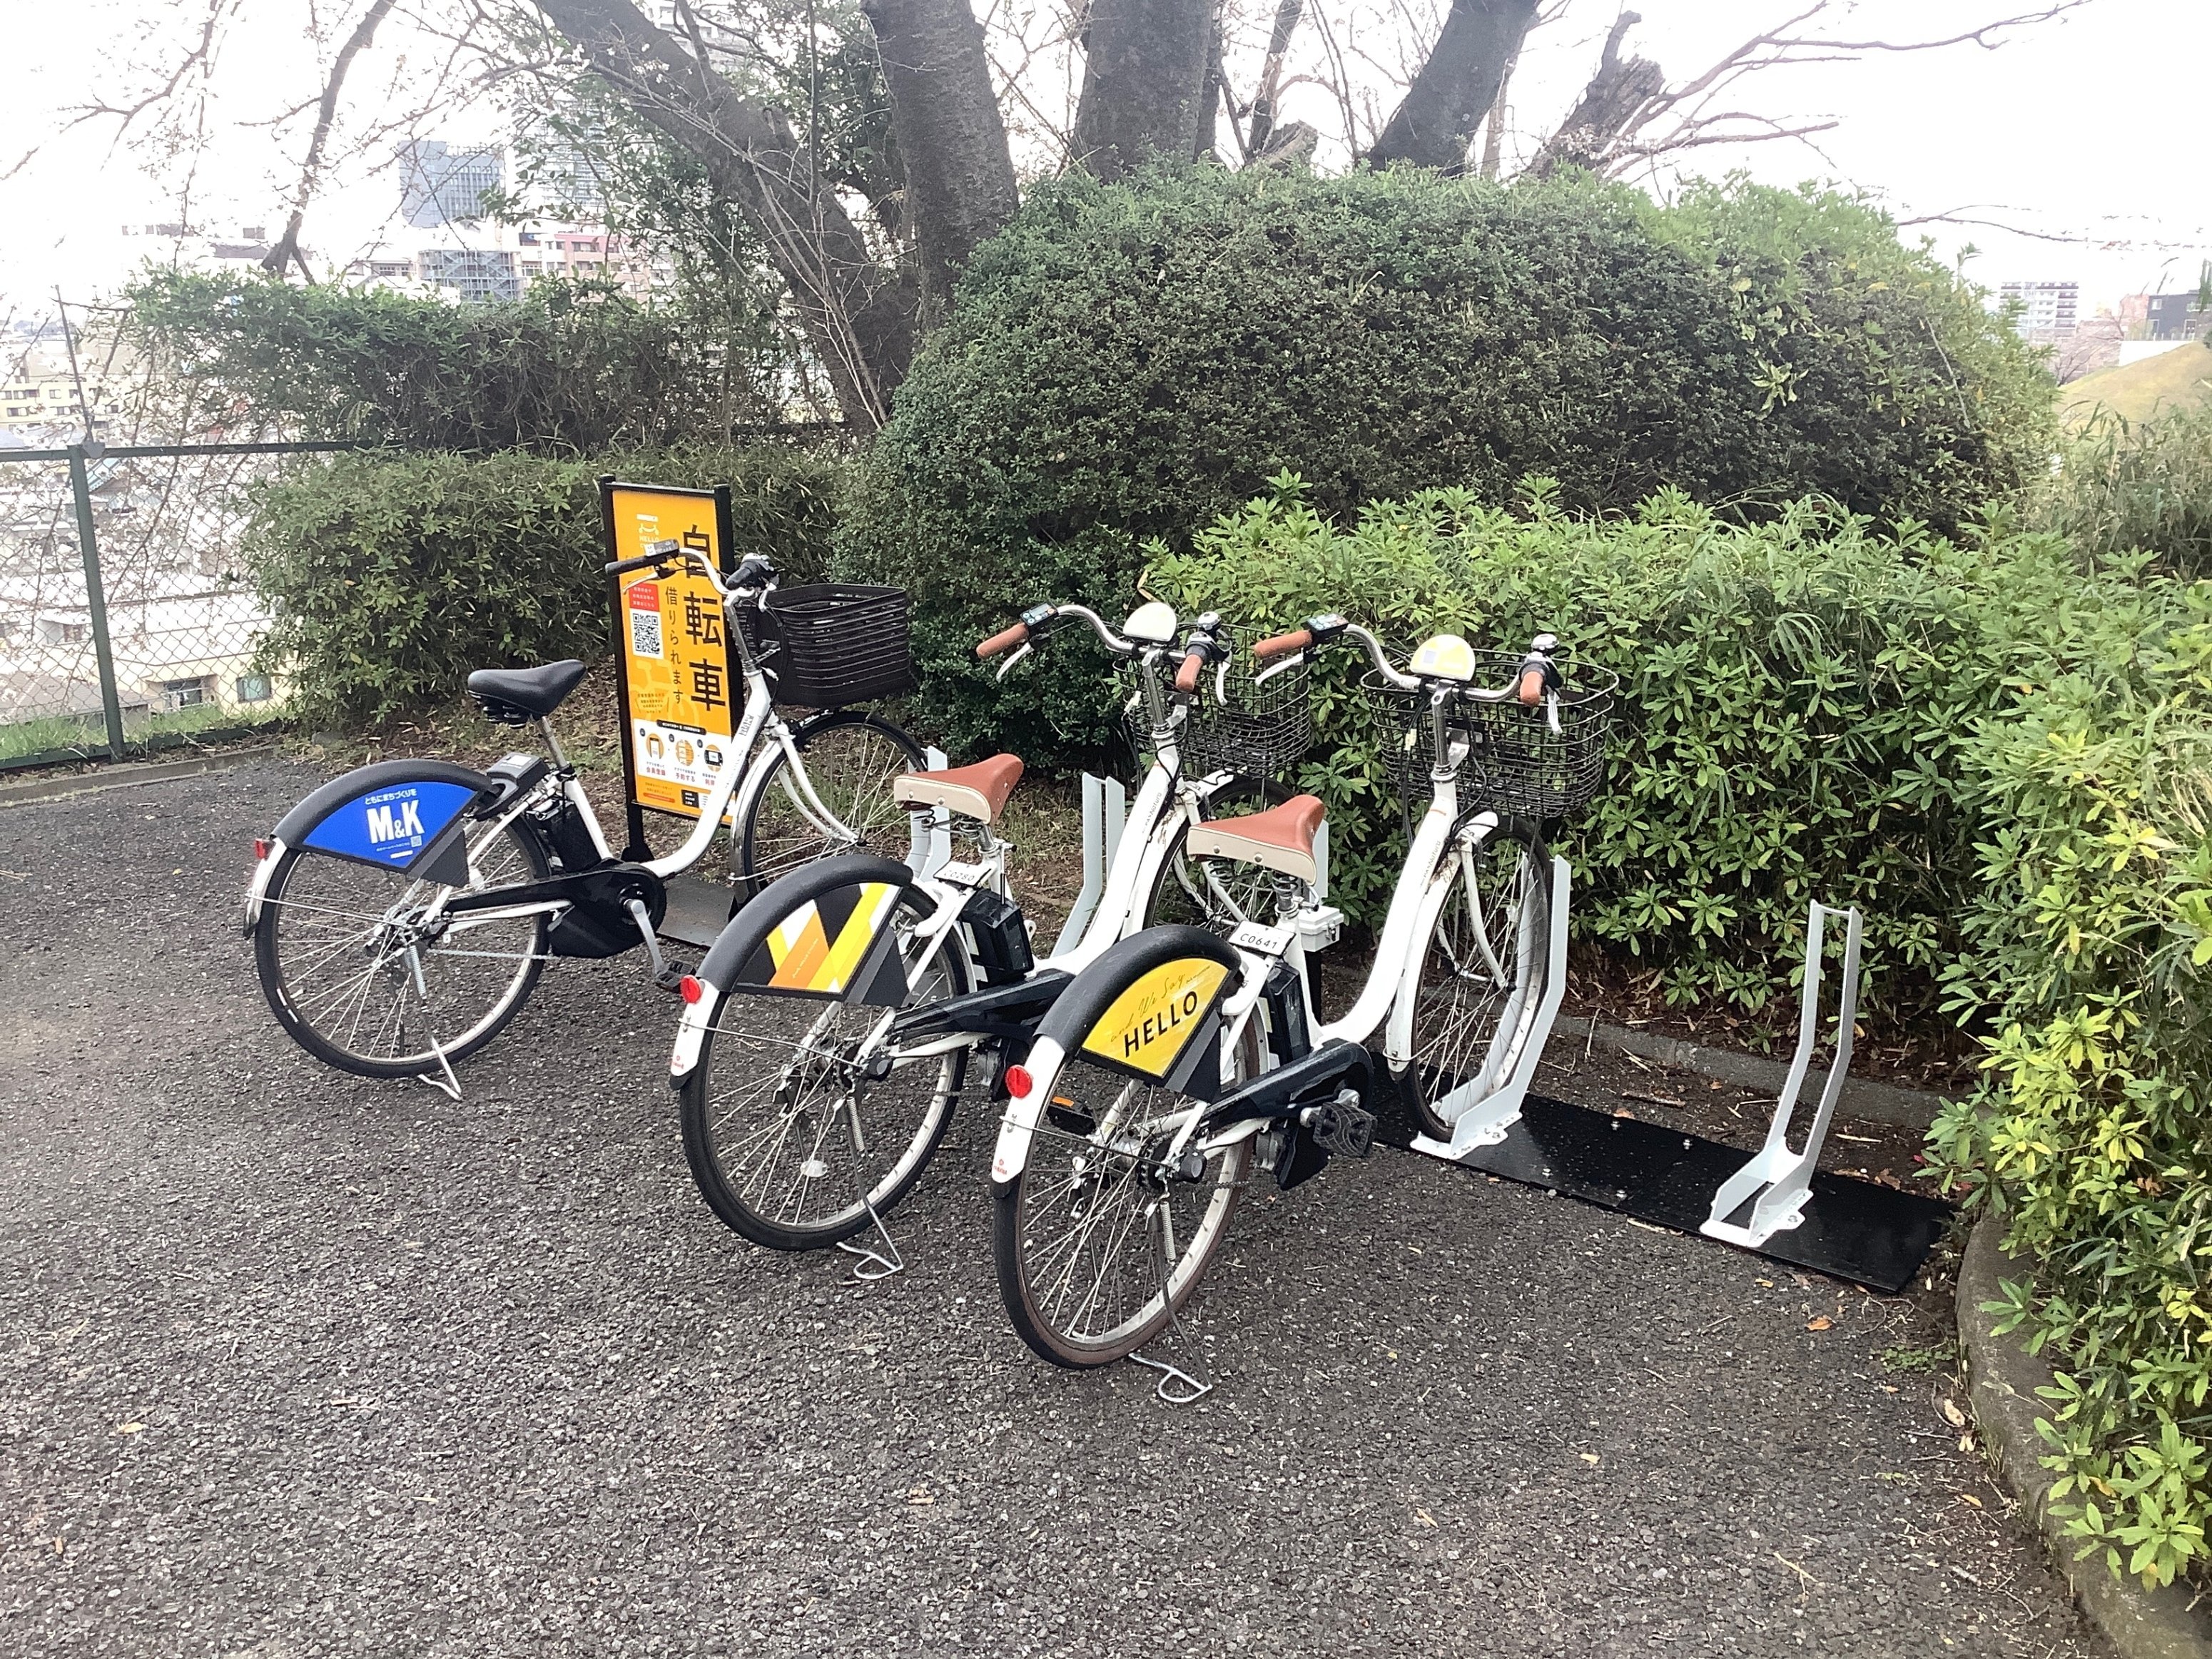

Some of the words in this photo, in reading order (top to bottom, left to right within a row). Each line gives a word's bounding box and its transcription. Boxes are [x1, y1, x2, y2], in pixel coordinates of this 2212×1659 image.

[683, 524, 726, 712] 自転車
[665, 586, 684, 704] 借りられます
[365, 788, 417, 805] ともにまちづくりを
[366, 799, 425, 844] M&K
[943, 870, 975, 881] C0280
[1239, 933, 1278, 949] C0641
[1124, 991, 1198, 1058] HELLO
